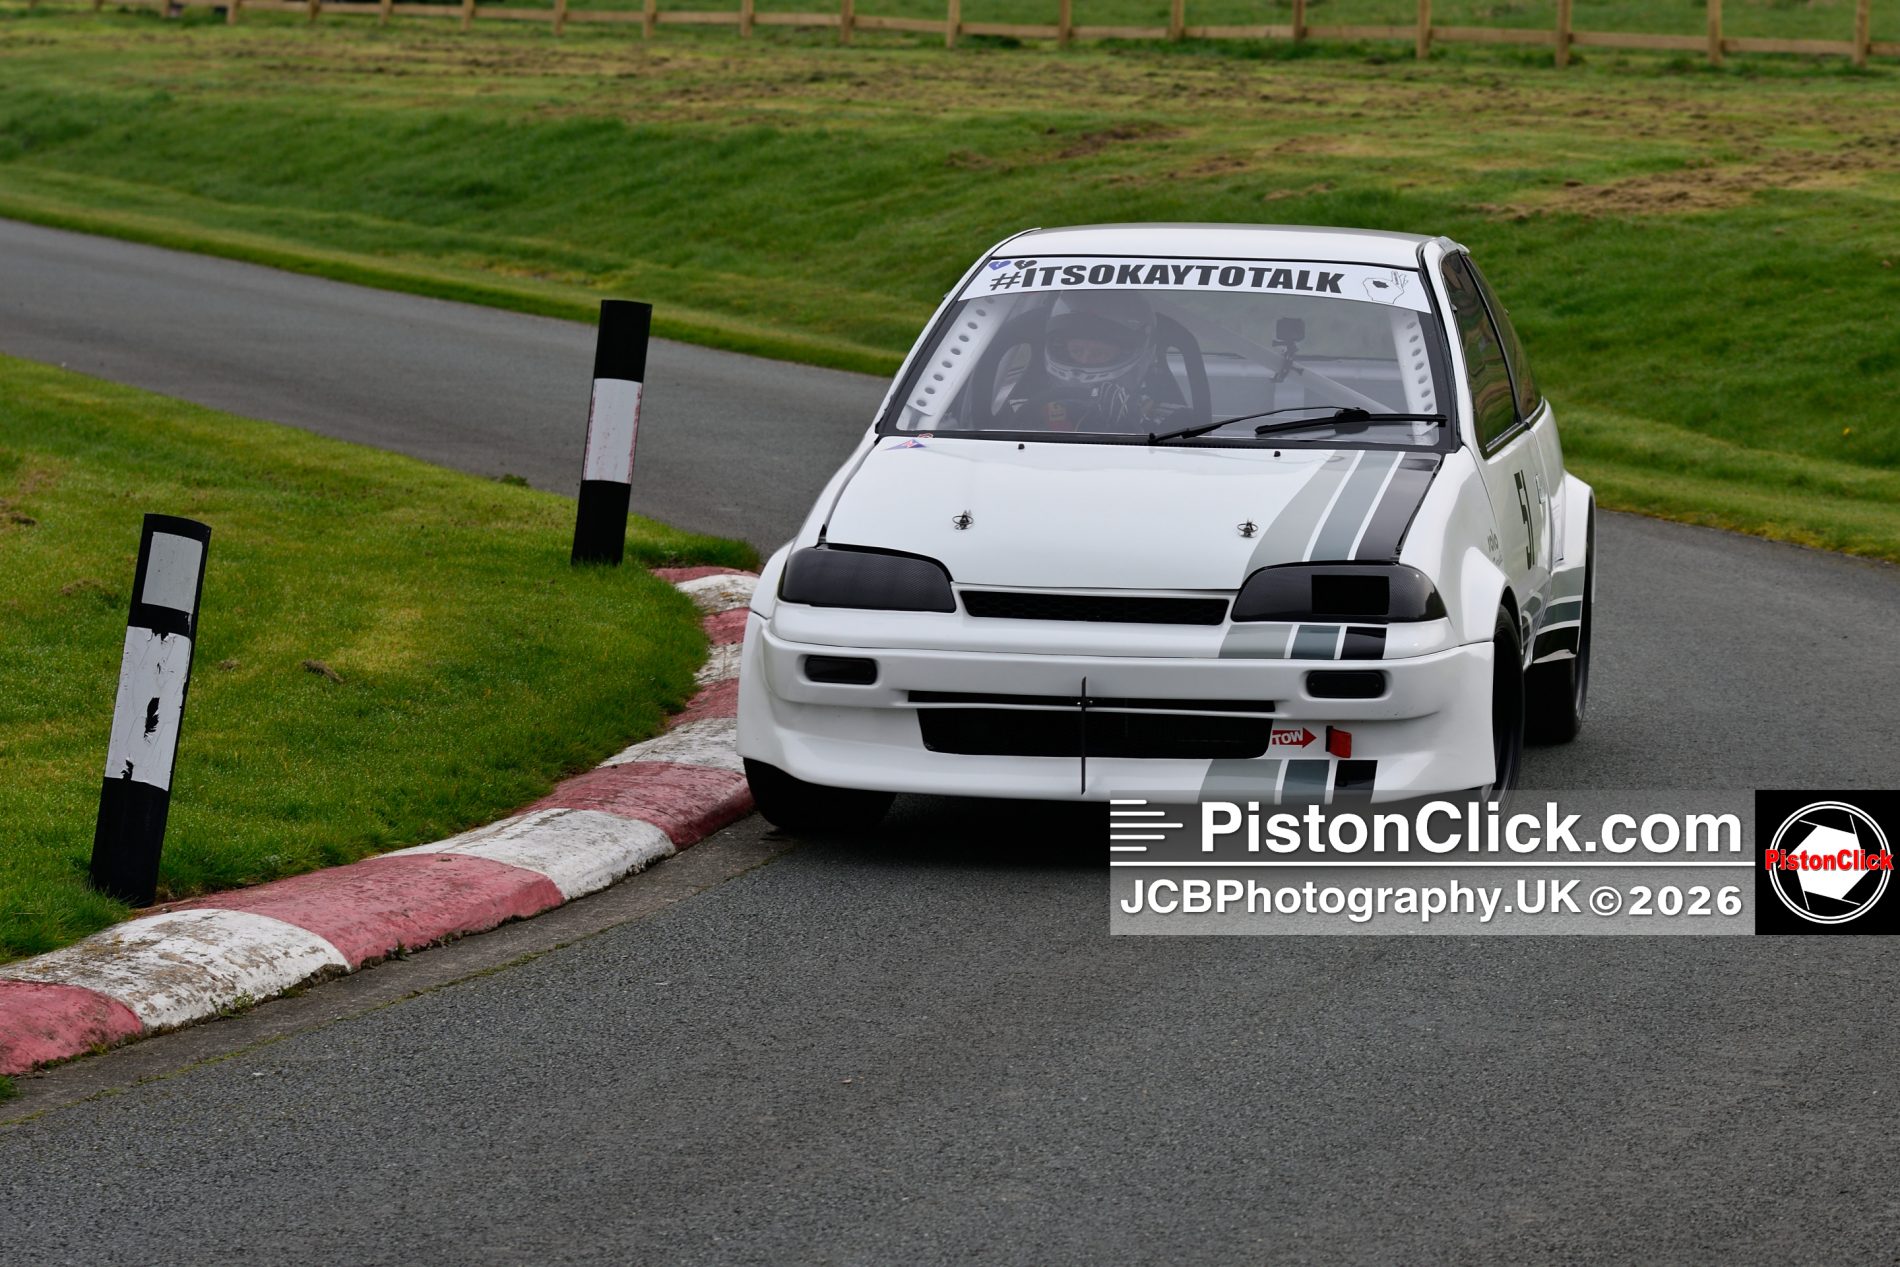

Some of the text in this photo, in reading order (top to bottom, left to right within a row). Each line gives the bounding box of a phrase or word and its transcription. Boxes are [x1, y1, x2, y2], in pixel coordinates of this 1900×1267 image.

[989, 263, 1345, 294] #ITSOKAYTOTALK
[1513, 469, 1535, 570] 51
[1271, 731, 1303, 746] TOW
